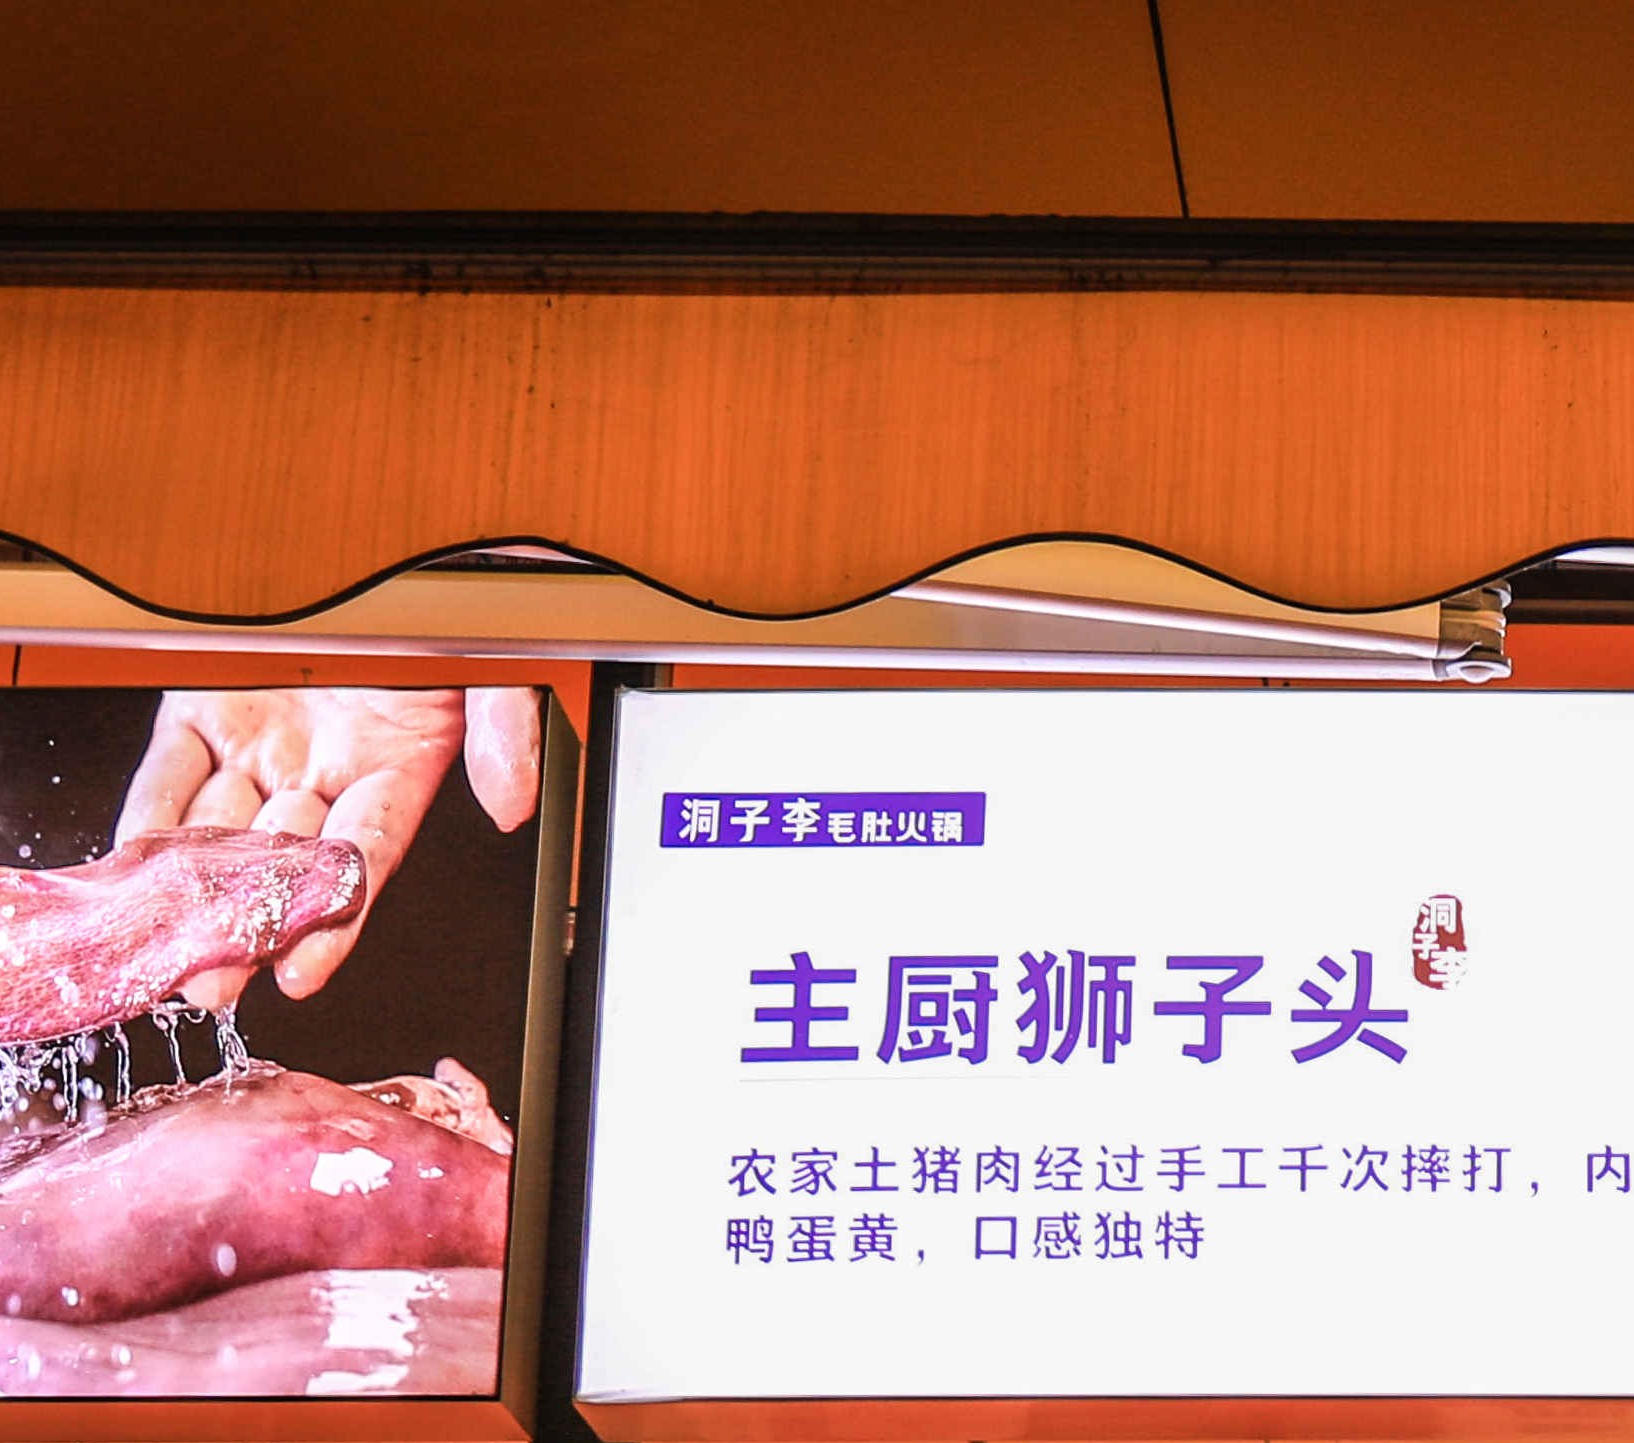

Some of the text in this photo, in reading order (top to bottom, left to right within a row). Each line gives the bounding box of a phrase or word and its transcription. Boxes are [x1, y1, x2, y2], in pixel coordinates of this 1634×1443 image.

[678, 796, 964, 845] 洞子李毛肚火锅
[739, 948, 1410, 1066] 主厨狮子头
[725, 1210, 1206, 1265] 鸭蛋黄，口感独特
